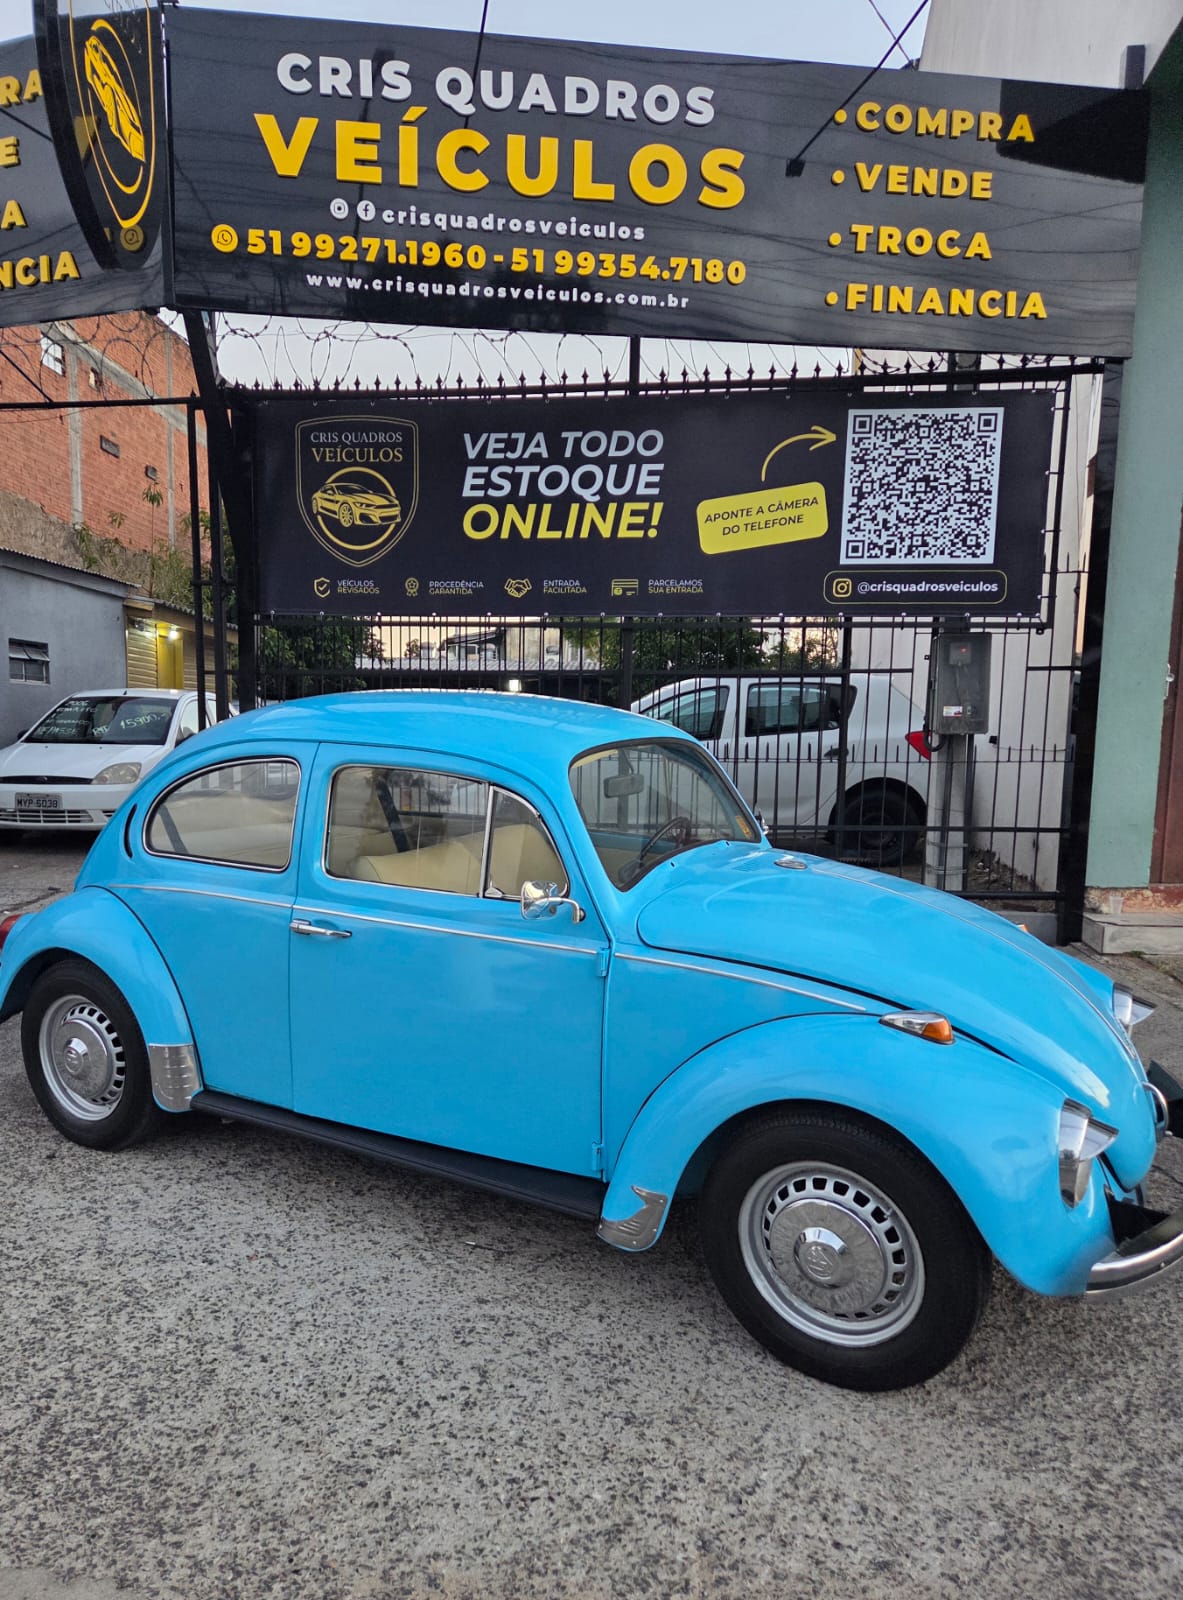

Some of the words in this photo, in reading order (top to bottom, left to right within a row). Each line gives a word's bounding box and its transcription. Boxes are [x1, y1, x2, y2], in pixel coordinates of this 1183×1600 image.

[276, 52, 413, 101] CRIS
[435, 65, 715, 126] QUADROS
[855, 101, 1036, 143] COMPRA
[253, 106, 746, 209] VEÍCULOS
[855, 162, 994, 200] VENDE
[381, 205, 646, 241] crisquadrosveiculos
[849, 223, 993, 260] TROCA
[247, 228, 282, 256] 51
[290, 231, 487, 270] 99271.1960
[511, 247, 545, 274] 51
[554, 249, 747, 286] 99354.7180
[306, 273, 690, 309] www.crisquadrosveiculos.com.br
[845, 281, 1048, 320] FINANCIA
[310, 431, 339, 444] CRIS
[341, 431, 403, 446] QUADROS
[463, 432, 549, 460] VEJA
[561, 429, 664, 458] TODO
[311, 444, 404, 462] VEÍCULOS
[461, 463, 665, 502] ESTOQUE
[462, 502, 664, 540] ONLINE!
[704, 507, 753, 524] APONTE
[755, 505, 765, 516] A
[767, 496, 819, 513] CÂMERA
[722, 524, 741, 536] DO
[743, 513, 804, 532] TELEFONE
[337, 579, 375, 587] VEÍCULOS
[337, 586, 380, 594] REVISADOS
[429, 579, 484, 588] PROCEDÊNCIA
[429, 587, 473, 595] GARANTIDA
[543, 579, 581, 587] ENTRADA
[543, 586, 587, 594] FACILITADA
[648, 579, 703, 587] PARCELAMOS
[648, 586, 664, 594] SUA
[666, 586, 704, 594] ENTRADA
[857, 580, 999, 595] @crisquadrosveiculos
